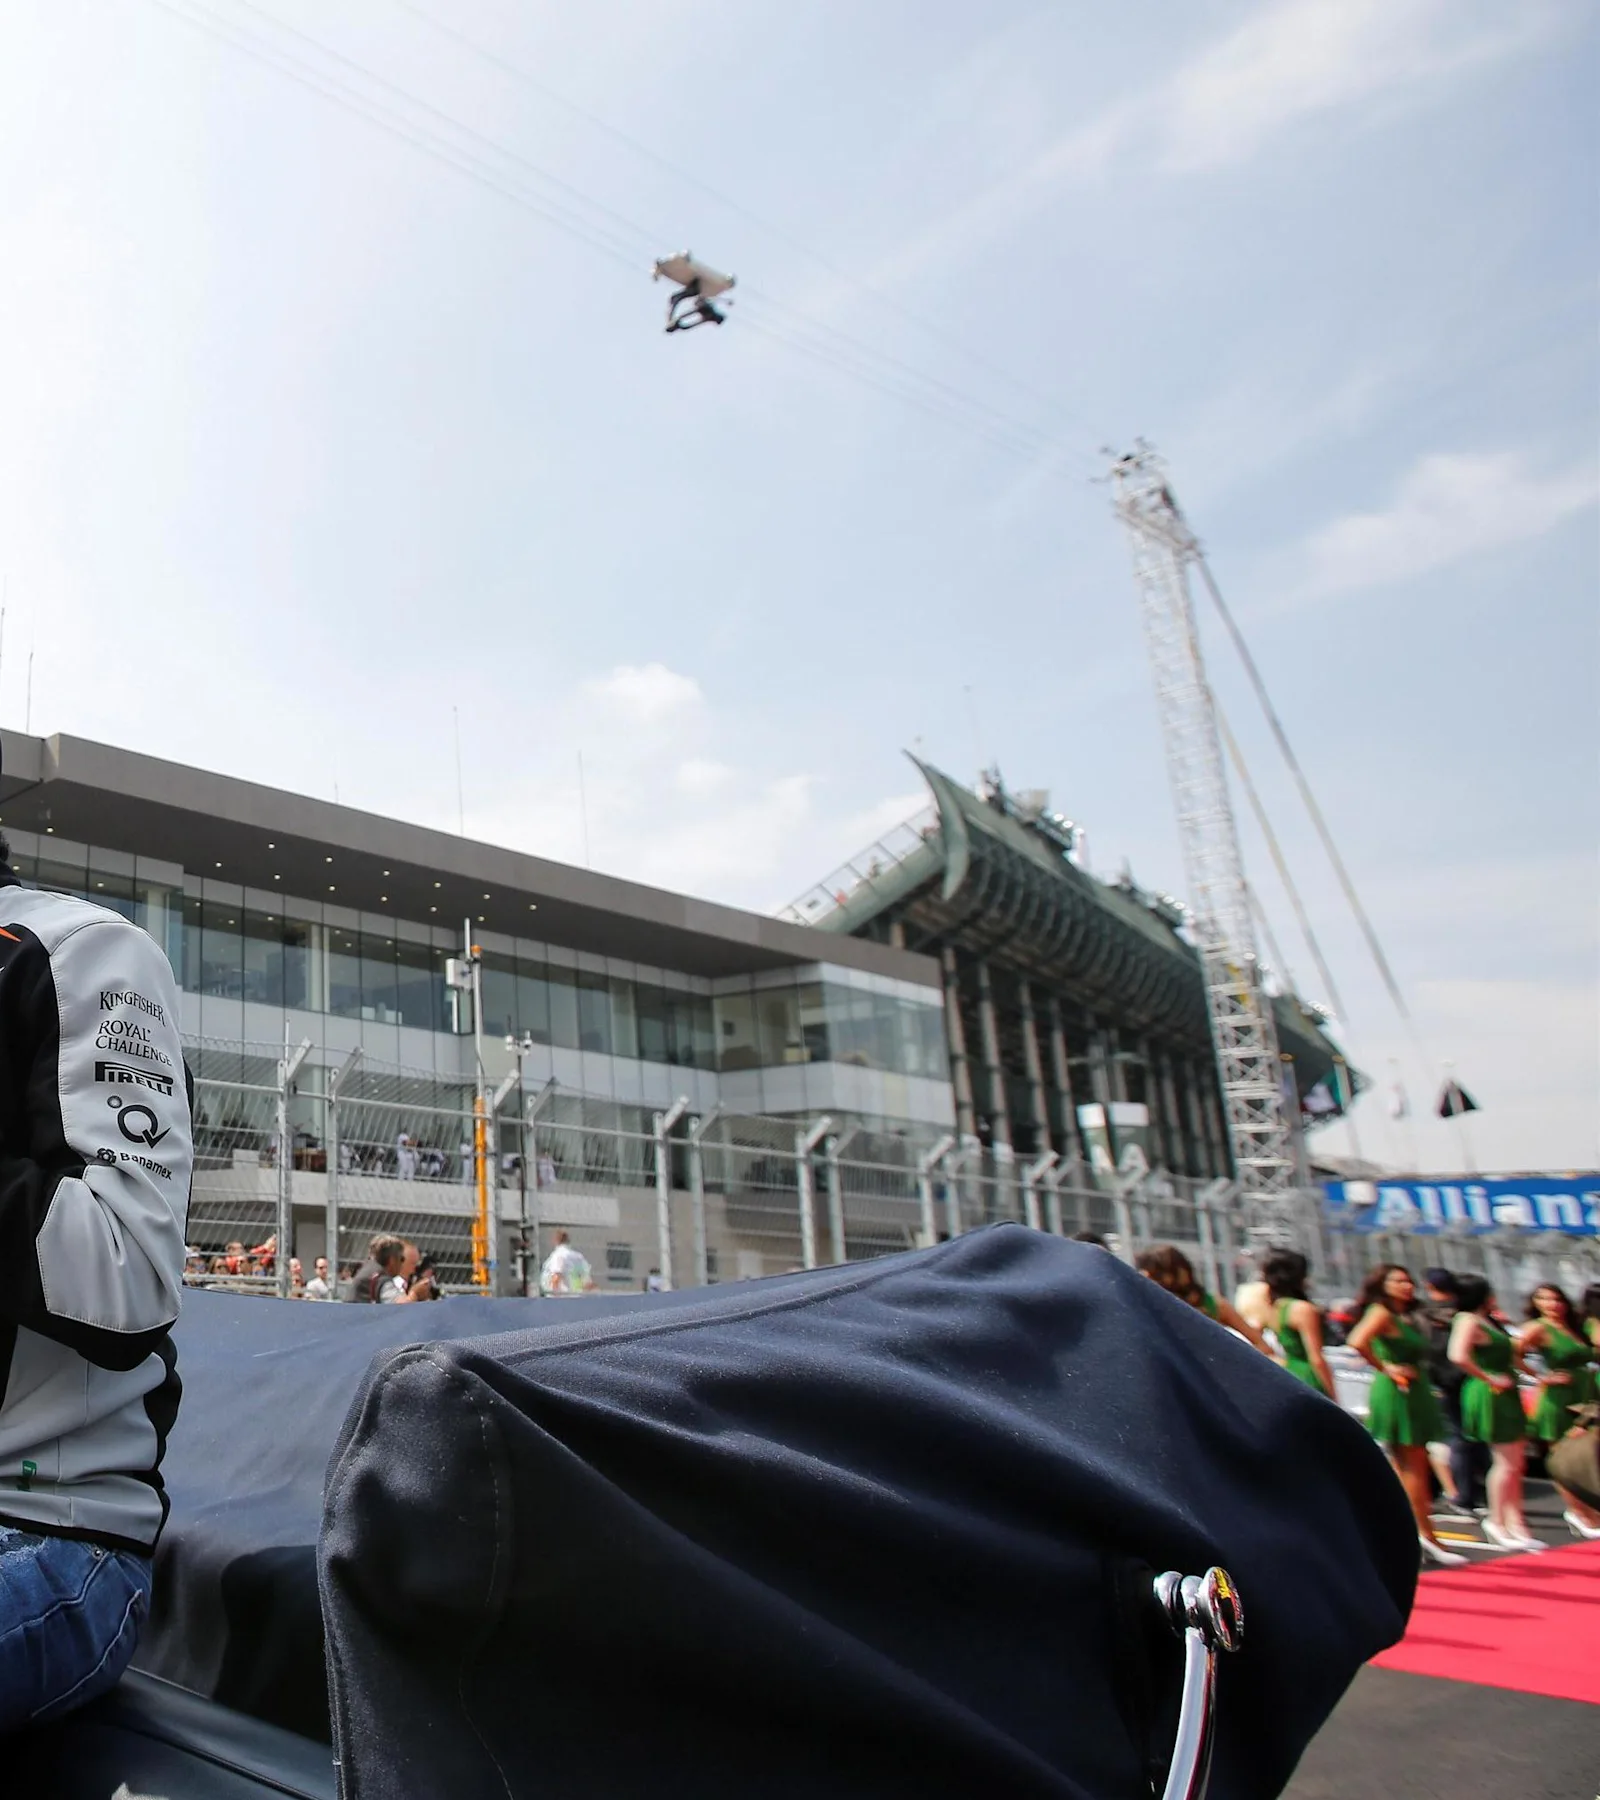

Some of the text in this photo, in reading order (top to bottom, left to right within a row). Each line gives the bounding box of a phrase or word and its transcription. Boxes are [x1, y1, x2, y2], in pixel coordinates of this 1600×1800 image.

[100, 991, 166, 1027] KINGFISHER
[99, 1020, 151, 1042] ROYAL
[95, 1035, 172, 1067] CHALLENGE
[95, 1061, 174, 1097] PIRELLI
[119, 1152, 172, 1181] Banamex
